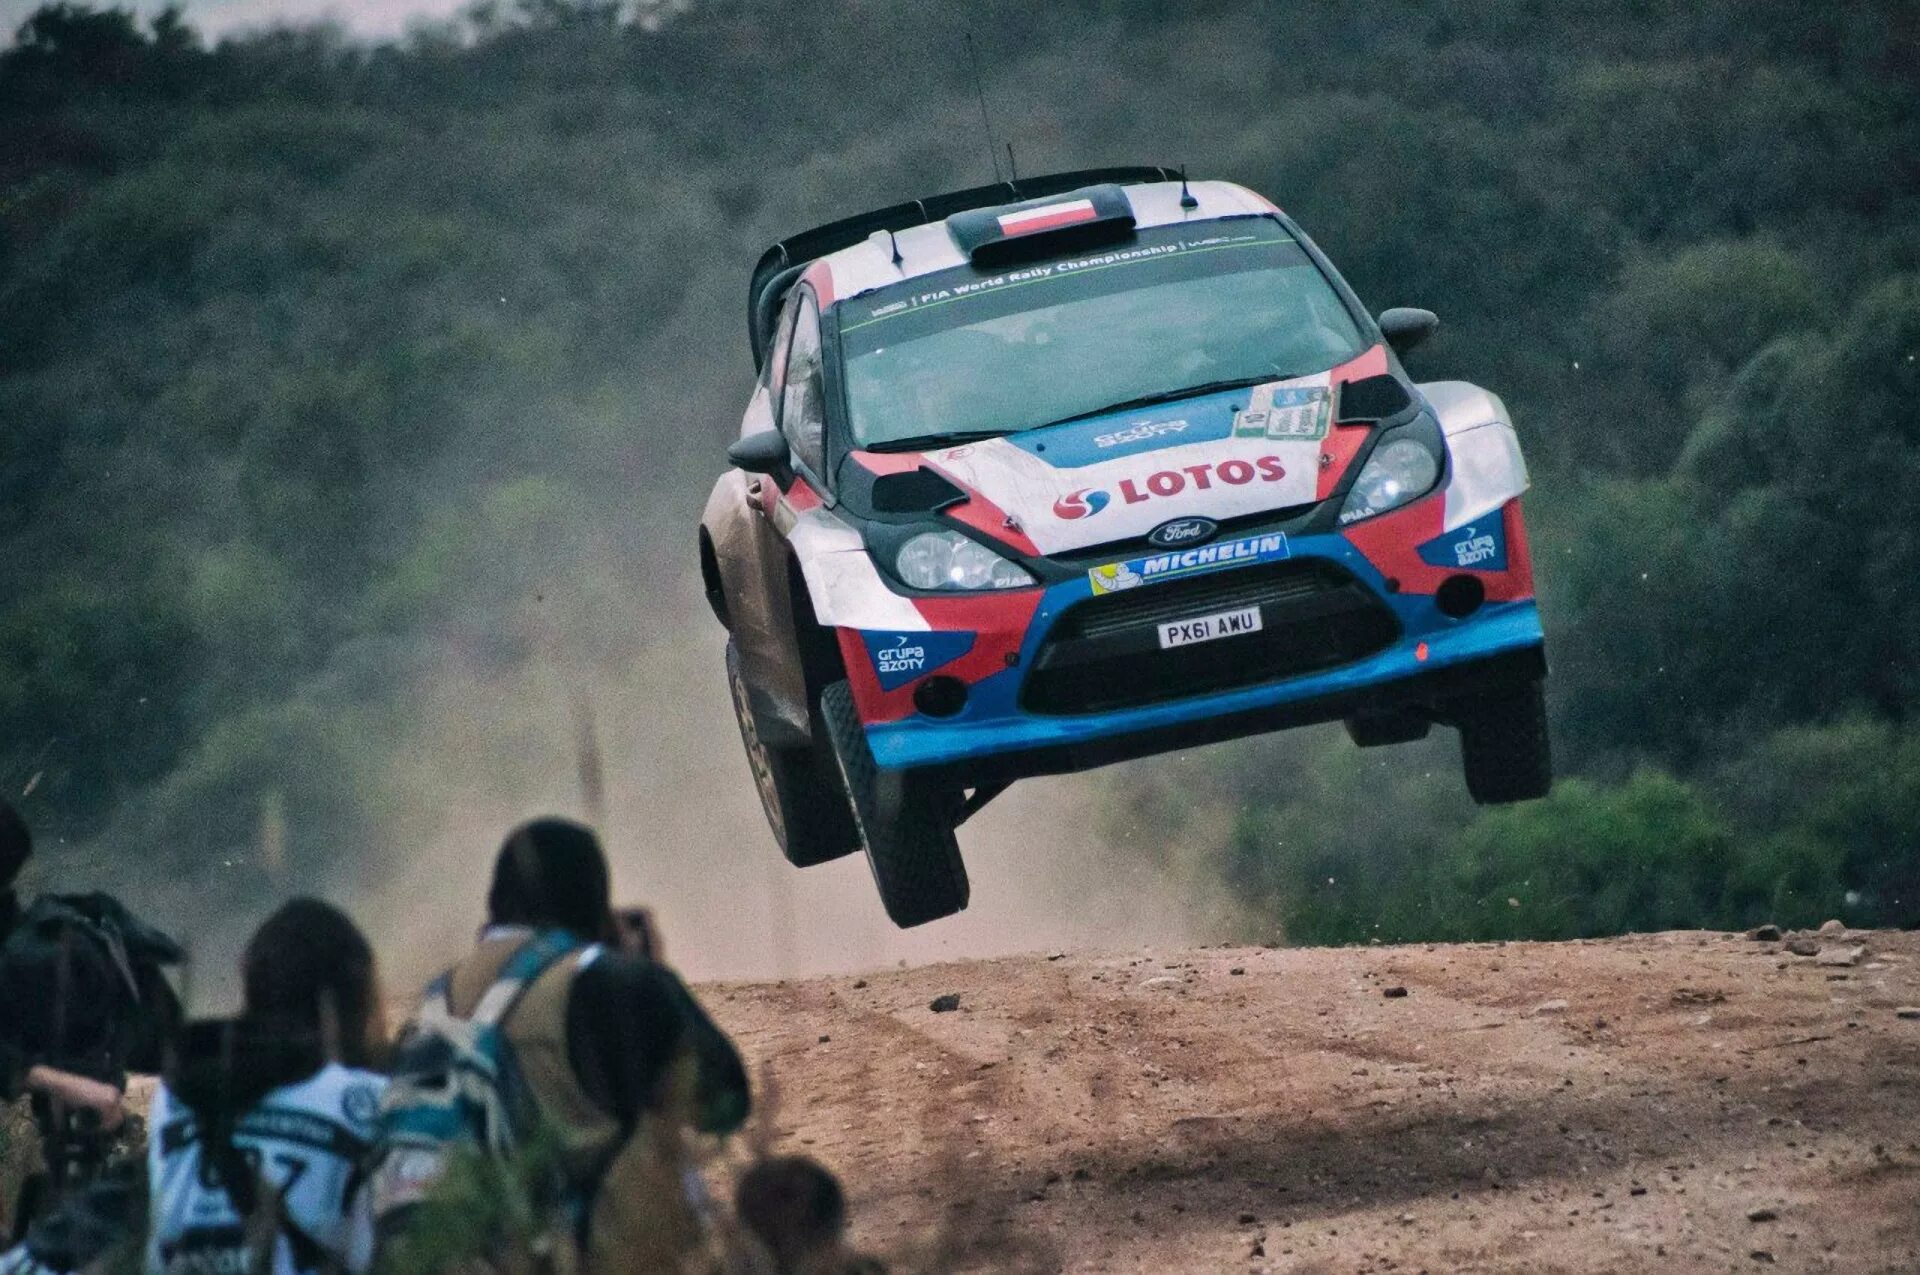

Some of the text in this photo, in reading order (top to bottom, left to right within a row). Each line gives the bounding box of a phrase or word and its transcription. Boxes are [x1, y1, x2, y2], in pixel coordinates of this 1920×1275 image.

[922, 244, 1178, 303] FIA World Rally Championship
[1118, 456, 1287, 505] LOTOS
[1163, 521, 1202, 542] Ford
[1143, 535, 1282, 575] MICHELIN
[1167, 612, 1254, 644] PX61 AWU
